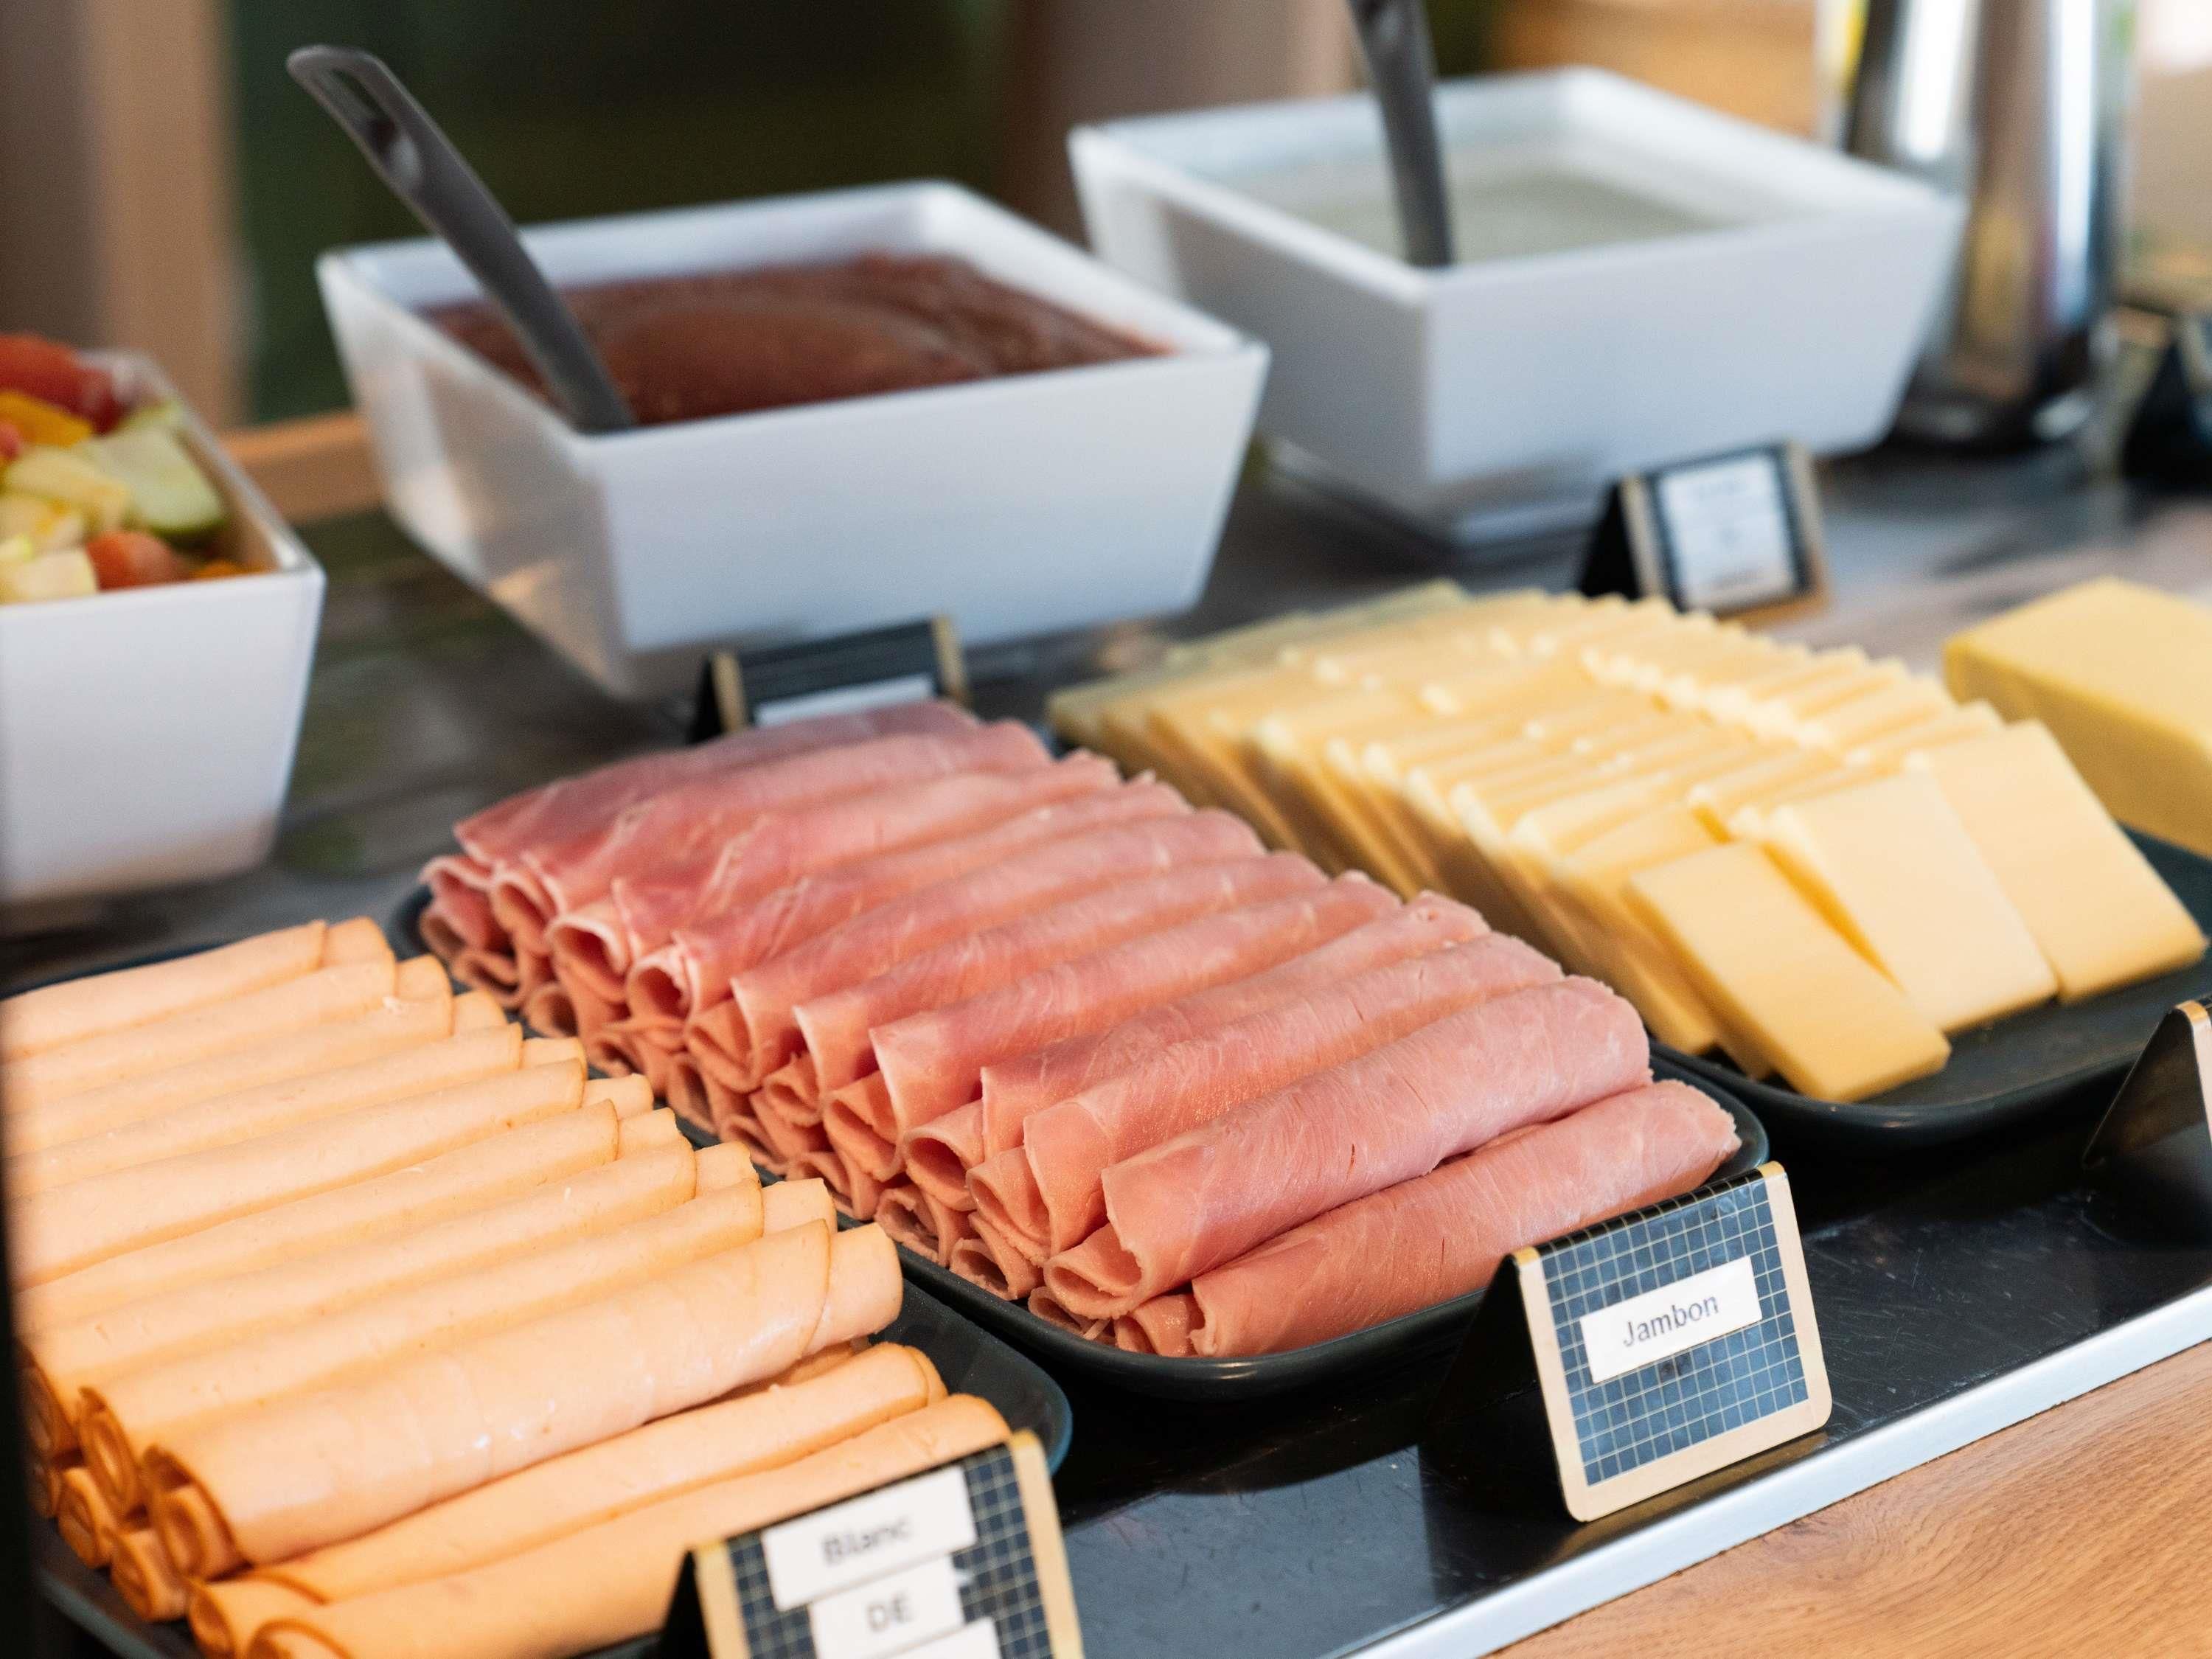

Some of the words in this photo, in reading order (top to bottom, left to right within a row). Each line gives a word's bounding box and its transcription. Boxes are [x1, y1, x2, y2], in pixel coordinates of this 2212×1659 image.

[1624, 1295, 1719, 1347] Jambon
[823, 1514, 911, 1565] Blanc
[866, 1593, 913, 1633] DE
